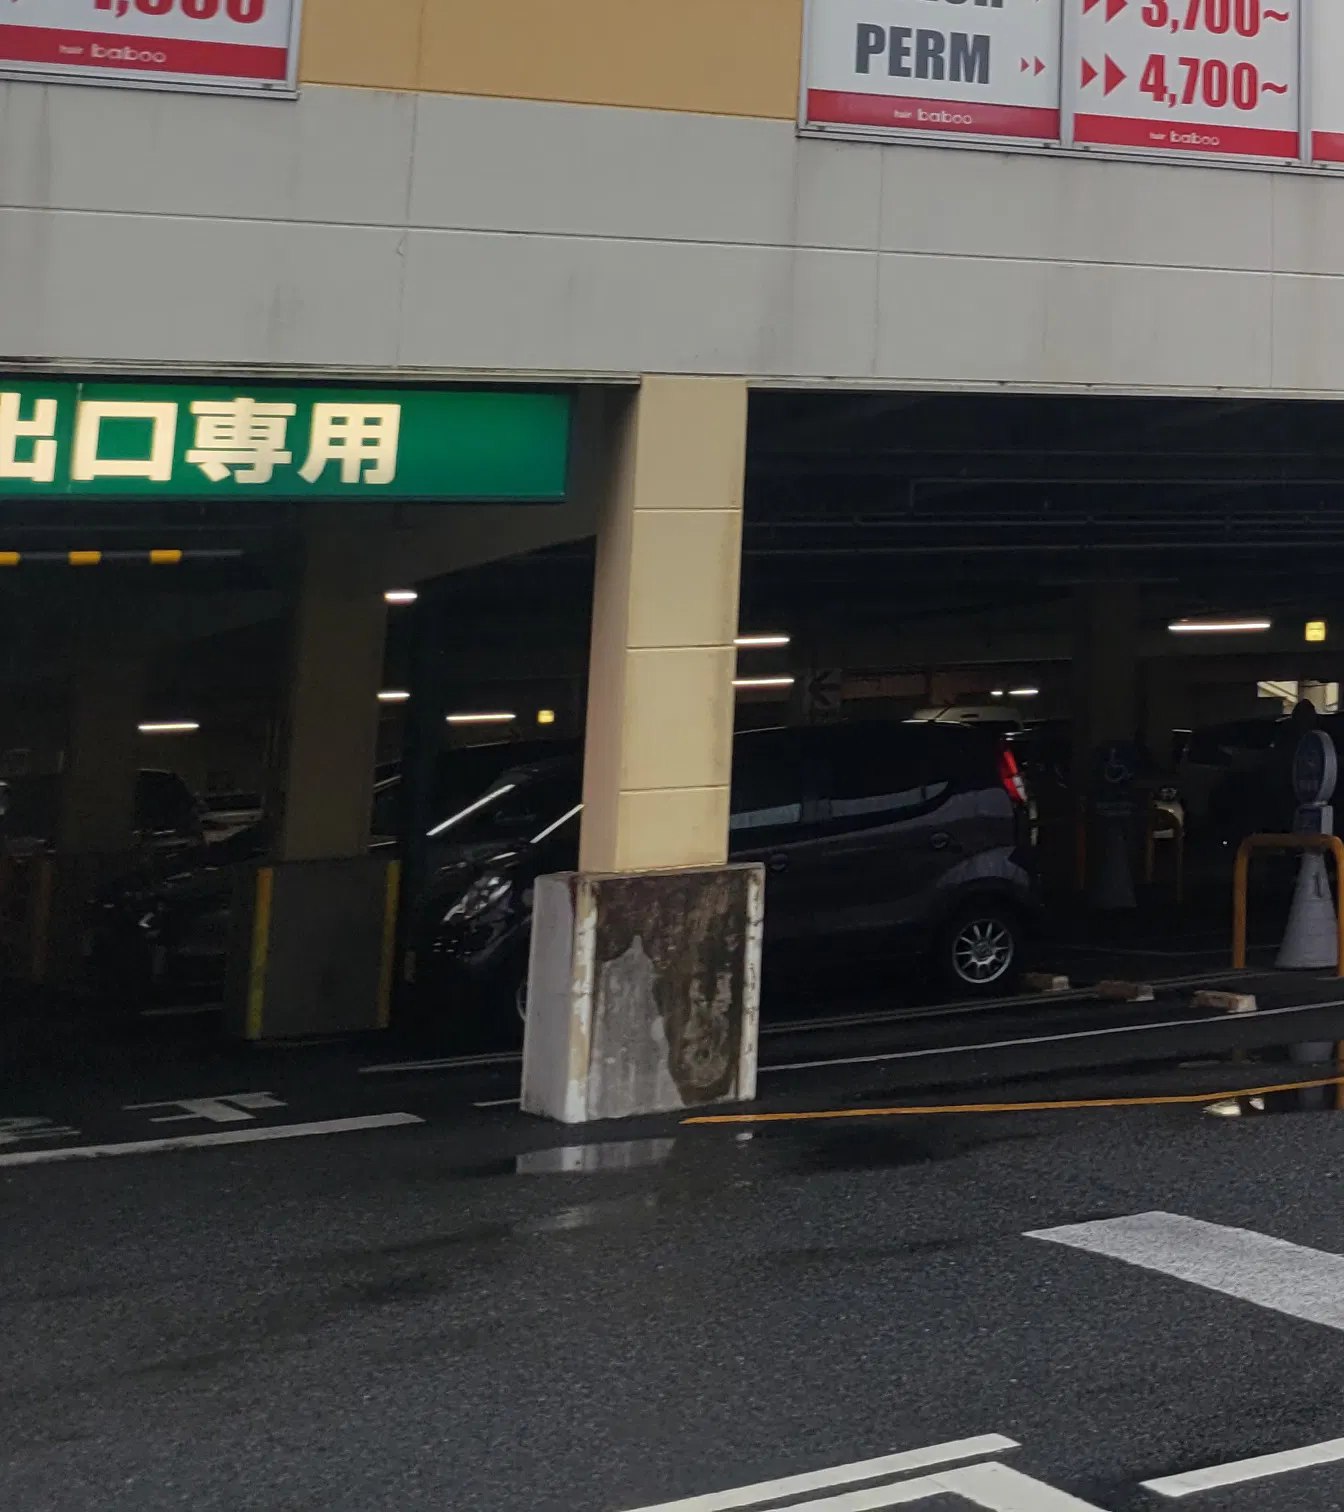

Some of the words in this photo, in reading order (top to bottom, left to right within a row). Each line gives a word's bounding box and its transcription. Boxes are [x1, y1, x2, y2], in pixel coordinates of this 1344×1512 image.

[91, 43, 167, 63] baboo
[855, 23, 990, 85] PERM
[917, 109, 972, 124] baboo
[1169, 130, 1220, 146] baboo
[0, 391, 402, 485] 出口専用
